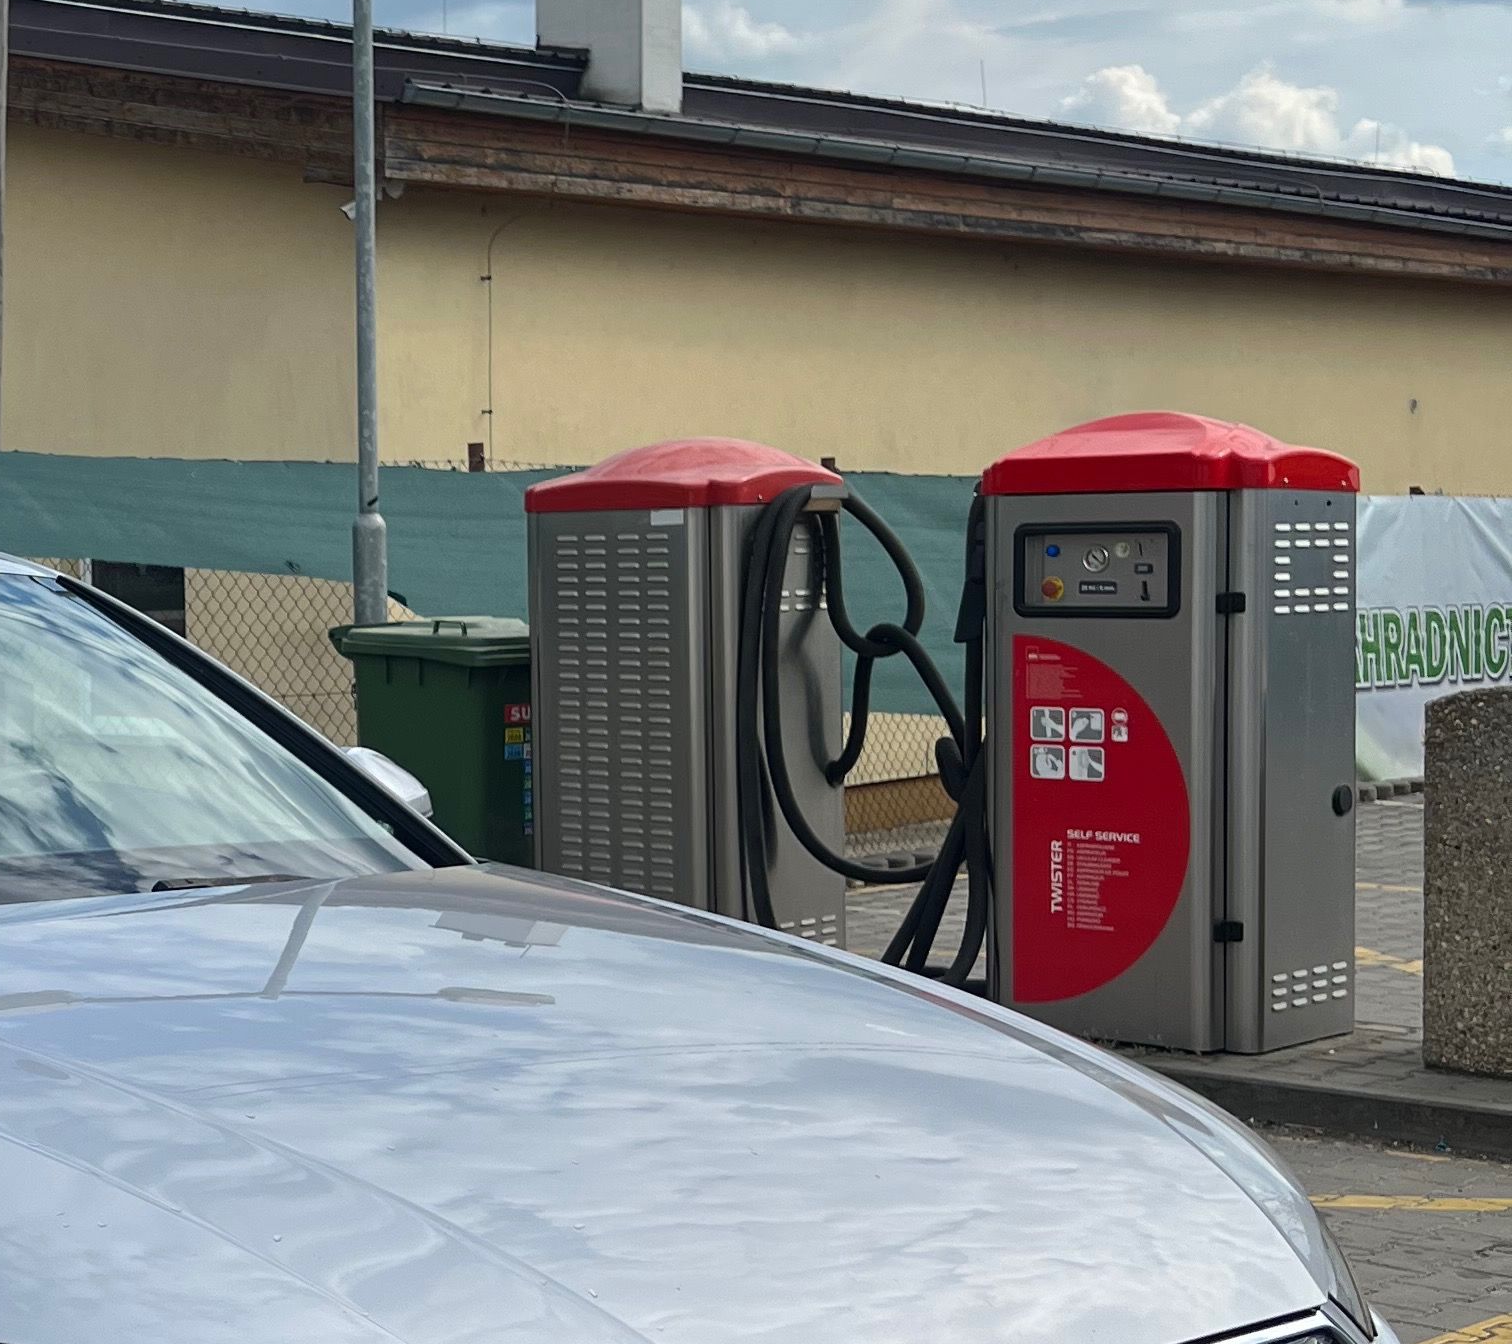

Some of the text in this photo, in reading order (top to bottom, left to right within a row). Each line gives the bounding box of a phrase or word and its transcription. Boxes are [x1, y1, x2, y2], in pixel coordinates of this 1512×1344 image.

[1356, 603, 1512, 689] HRADNIC
[1067, 828, 1141, 844] SELF SERVICE
[1050, 839, 1064, 914] TWISTER
